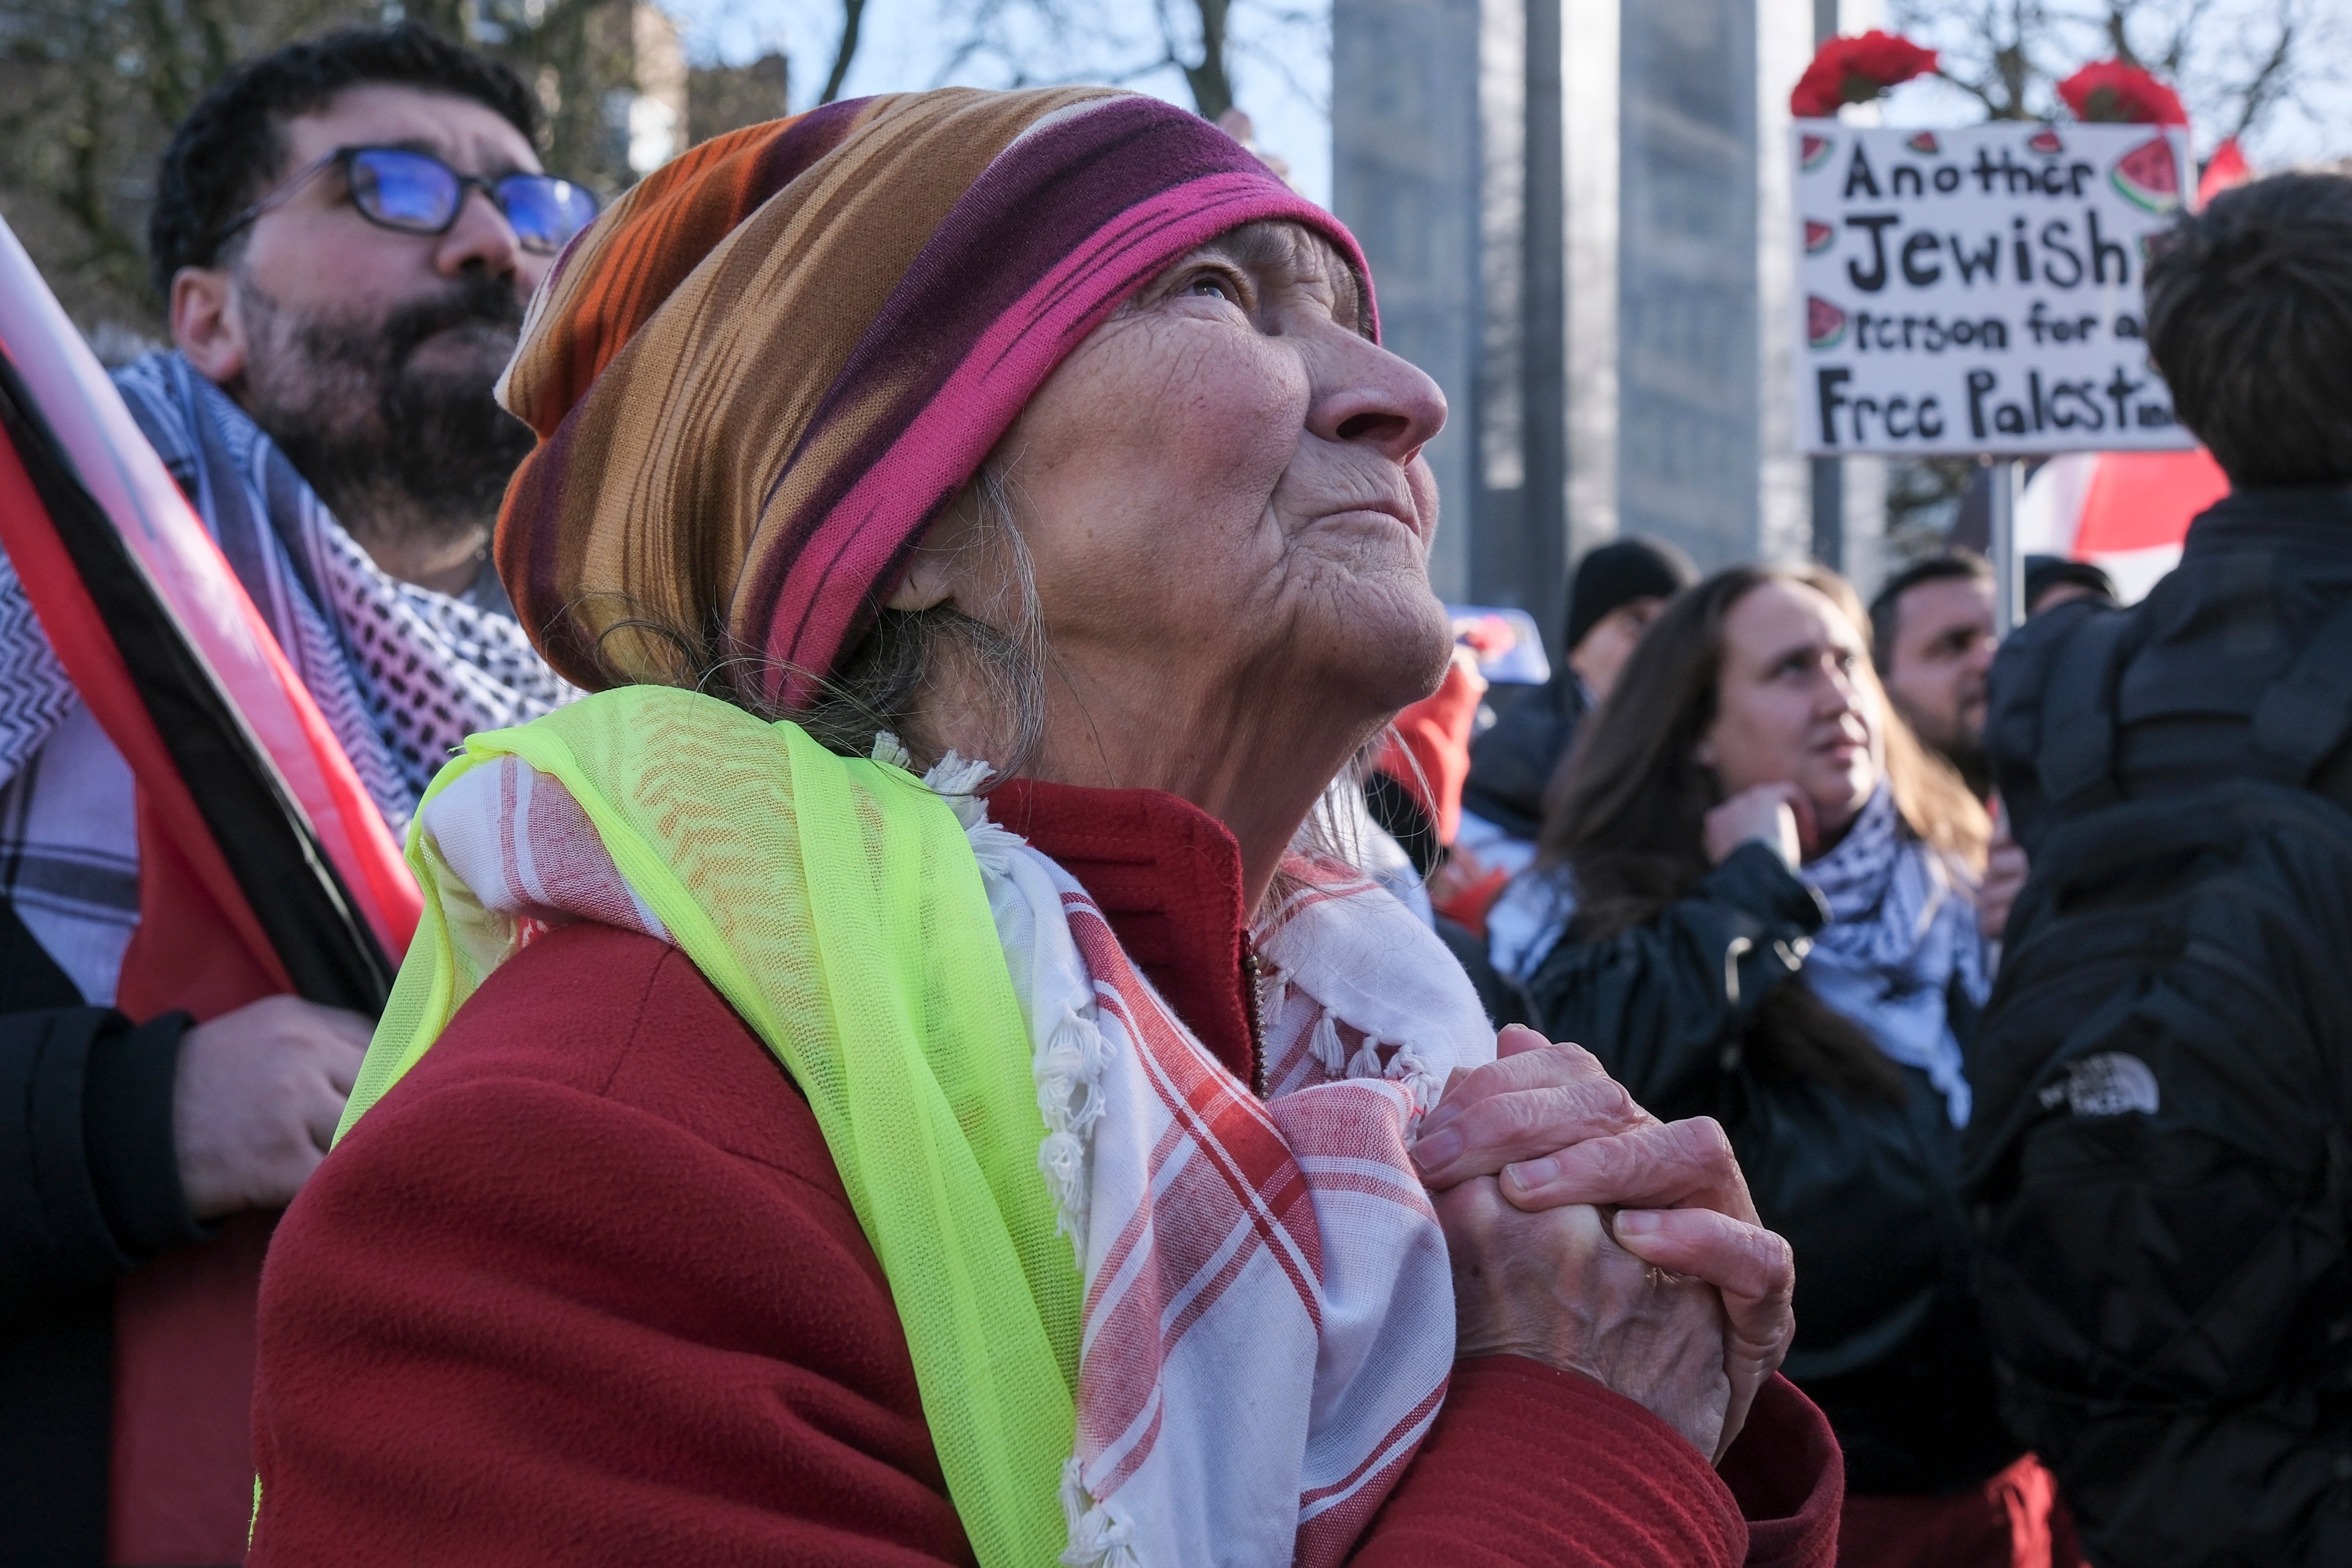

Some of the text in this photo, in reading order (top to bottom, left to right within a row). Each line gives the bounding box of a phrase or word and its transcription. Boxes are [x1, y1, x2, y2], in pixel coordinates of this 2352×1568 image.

[1843, 141, 2094, 199] Another
[1845, 209, 2129, 292] Jewish
[2027, 300, 2098, 344] for
[2114, 314, 2142, 338] a
[1816, 366, 1943, 444] Free
